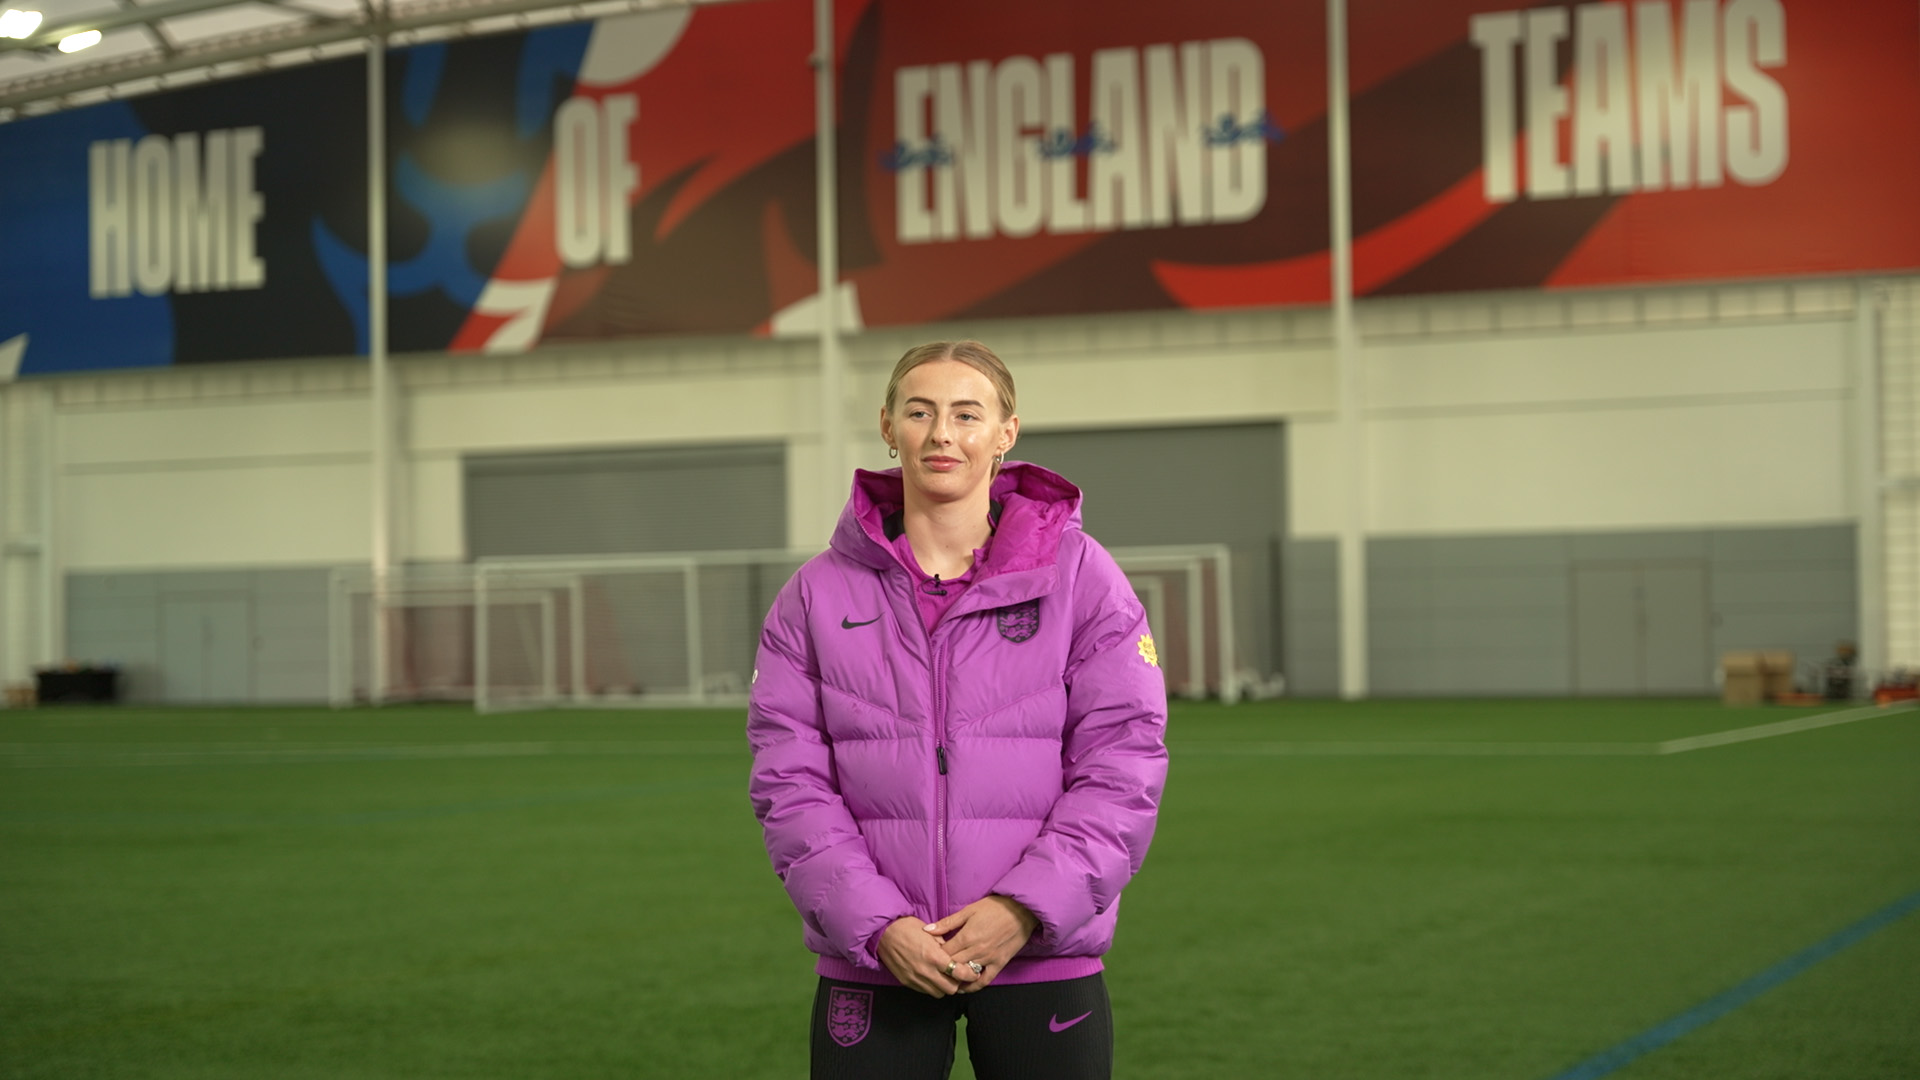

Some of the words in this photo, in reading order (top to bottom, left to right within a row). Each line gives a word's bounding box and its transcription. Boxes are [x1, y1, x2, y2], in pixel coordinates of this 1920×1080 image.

[89, 127, 264, 298] HOME
[554, 94, 639, 267] OF
[895, 37, 1267, 244] ENGLAND
[1470, 0, 1788, 203] TEAMS
